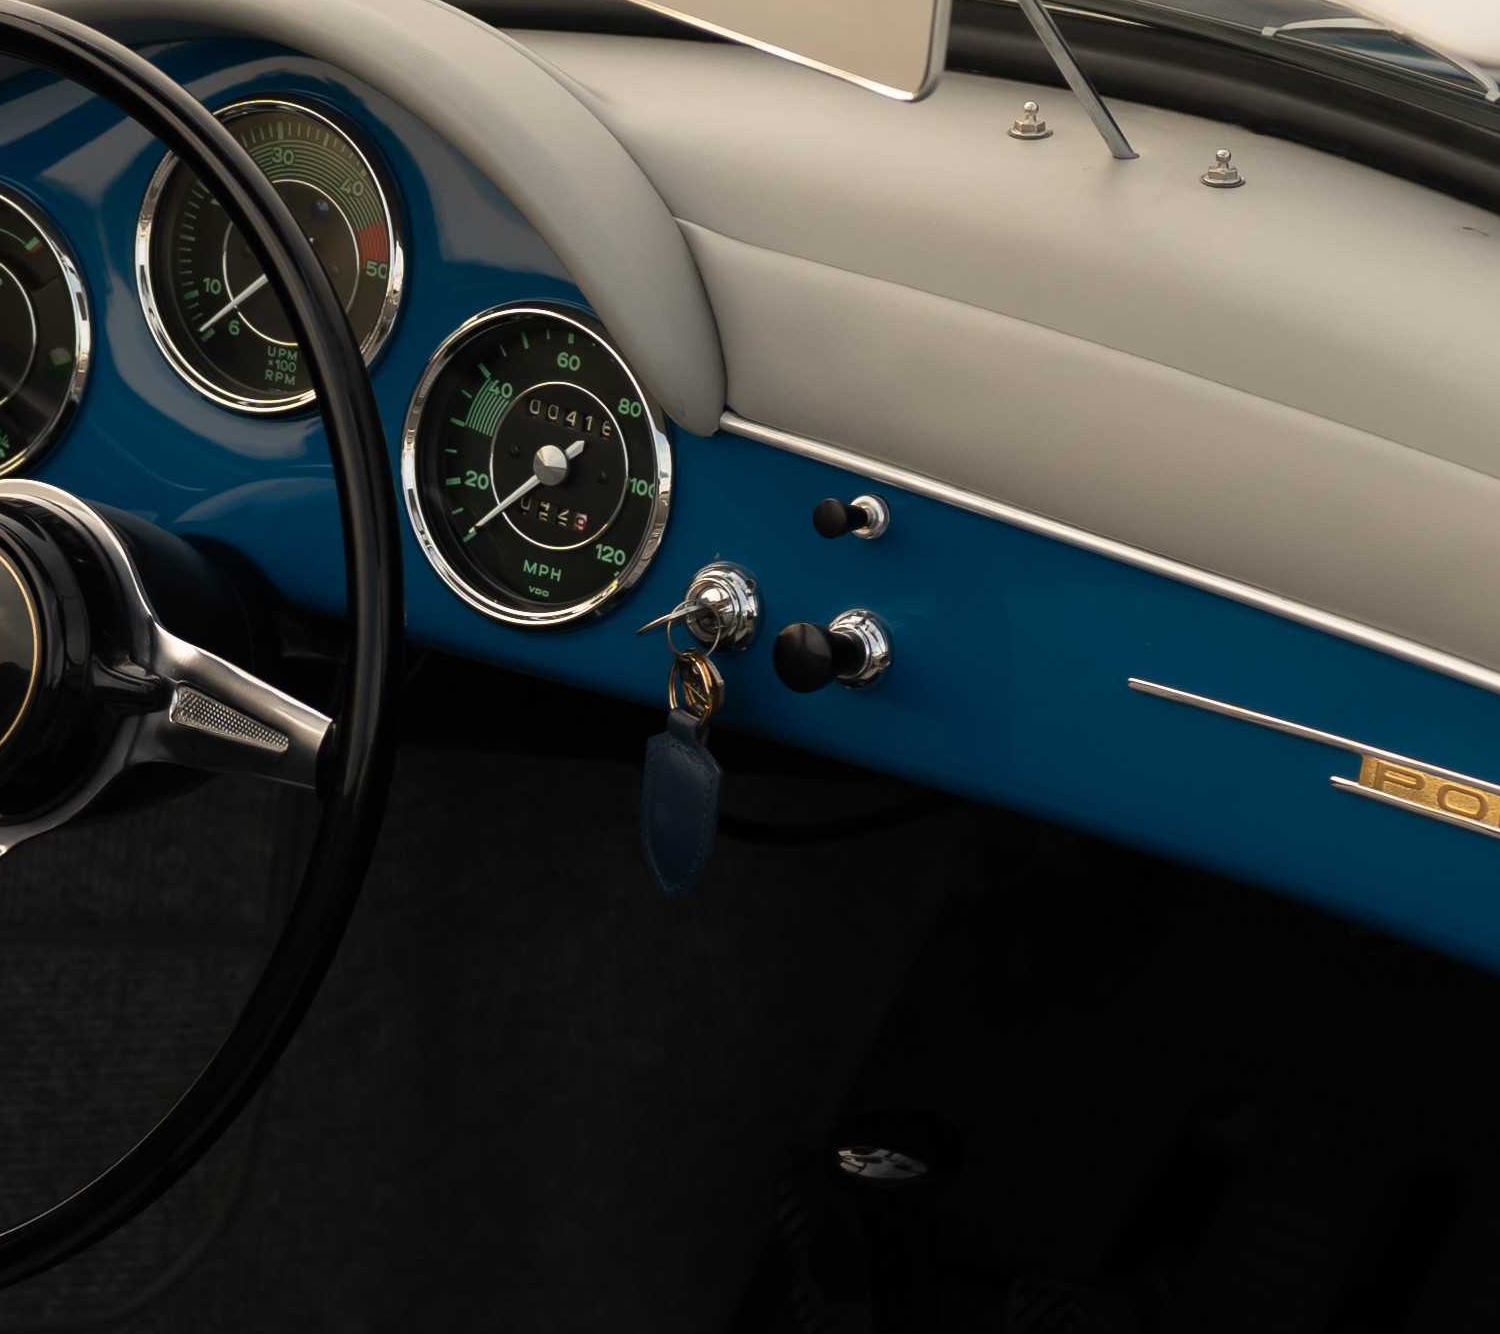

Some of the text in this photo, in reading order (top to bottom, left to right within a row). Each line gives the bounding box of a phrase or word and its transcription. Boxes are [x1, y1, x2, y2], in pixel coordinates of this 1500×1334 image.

[272, 146, 295, 166] 30
[339, 178, 364, 197] 40
[366, 259, 389, 280] 50
[203, 277, 222, 295] 10
[228, 319, 240, 336] 6
[267, 345, 298, 362] UPM
[556, 351, 581, 372] 60
[265, 369, 296, 386] RPM
[488, 379, 513, 399] 40
[617, 397, 642, 418] 80
[464, 470, 489, 490] 20
[595, 543, 626, 566] 120
[523, 559, 562, 582] MPH
[528, 585, 550, 598] VDO
